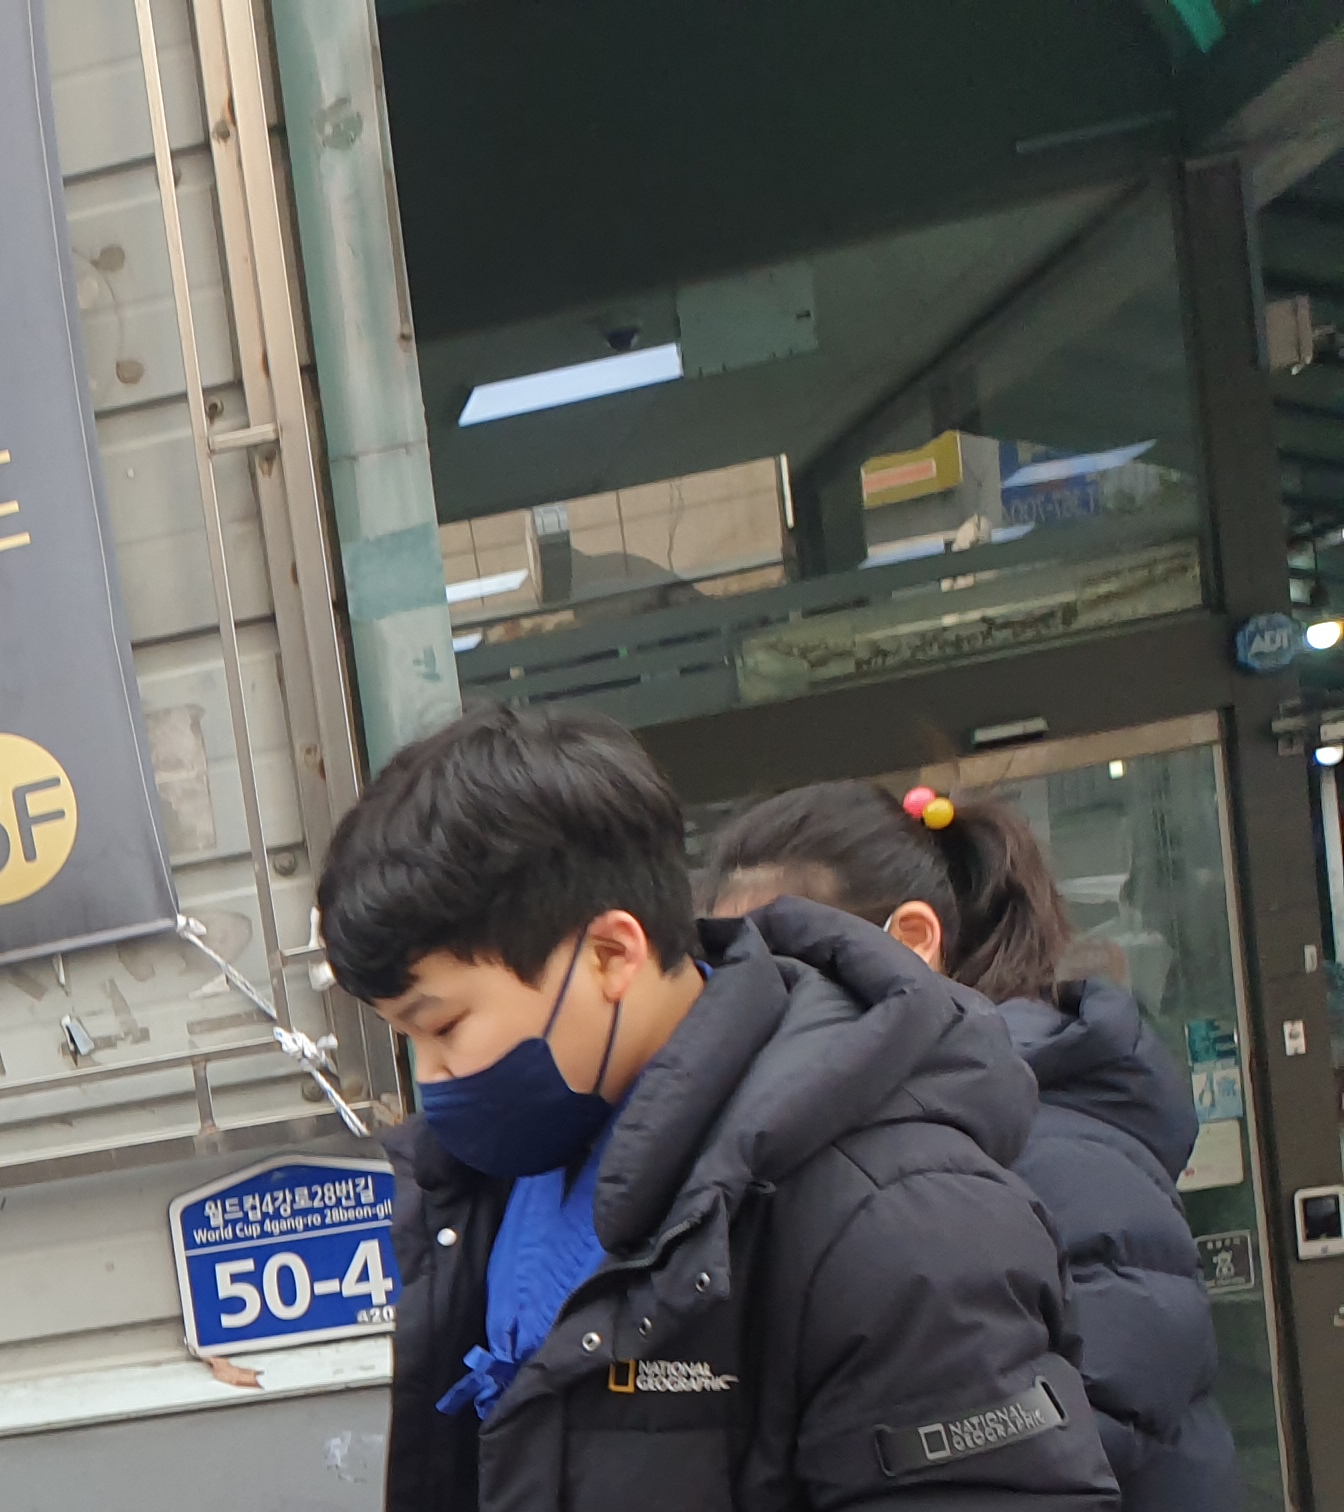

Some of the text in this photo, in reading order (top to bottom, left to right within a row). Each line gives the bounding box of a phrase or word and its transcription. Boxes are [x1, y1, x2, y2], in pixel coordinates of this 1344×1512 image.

[193, 1224, 233, 1245] World
[236, 1220, 261, 1239] Cup
[263, 1211, 322, 1236] 4gang-ro
[214, 1238, 394, 1329] 50-4
[638, 1360, 714, 1378] NATIONAL
[948, 1402, 1027, 1437] NATIONAL
[952, 1408, 1047, 1452] GEOGRAPHIC
